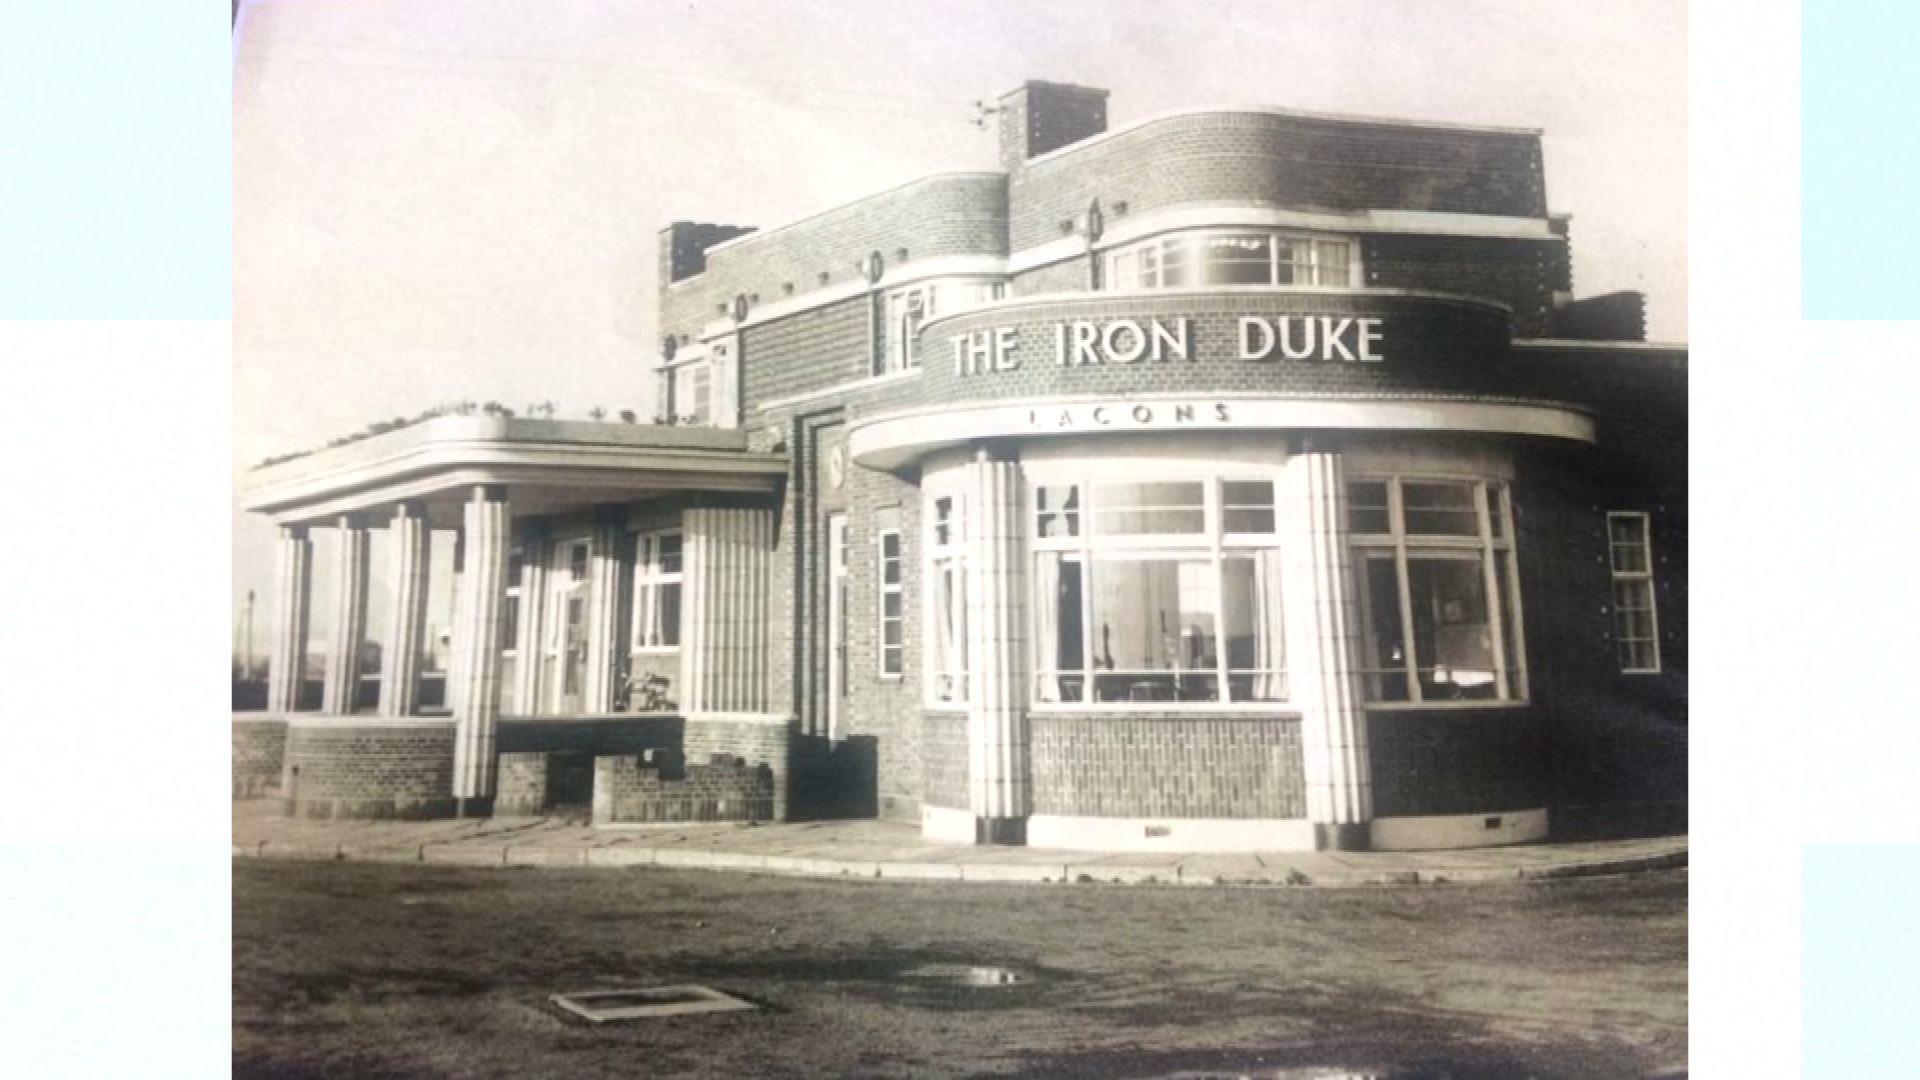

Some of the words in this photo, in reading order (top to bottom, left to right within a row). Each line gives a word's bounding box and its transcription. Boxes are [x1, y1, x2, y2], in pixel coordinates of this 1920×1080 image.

[949, 327, 1017, 377] THE
[1055, 318, 1187, 365] IRON
[1237, 316, 1384, 362] DUKE
[1029, 402, 1231, 427] LACONS
